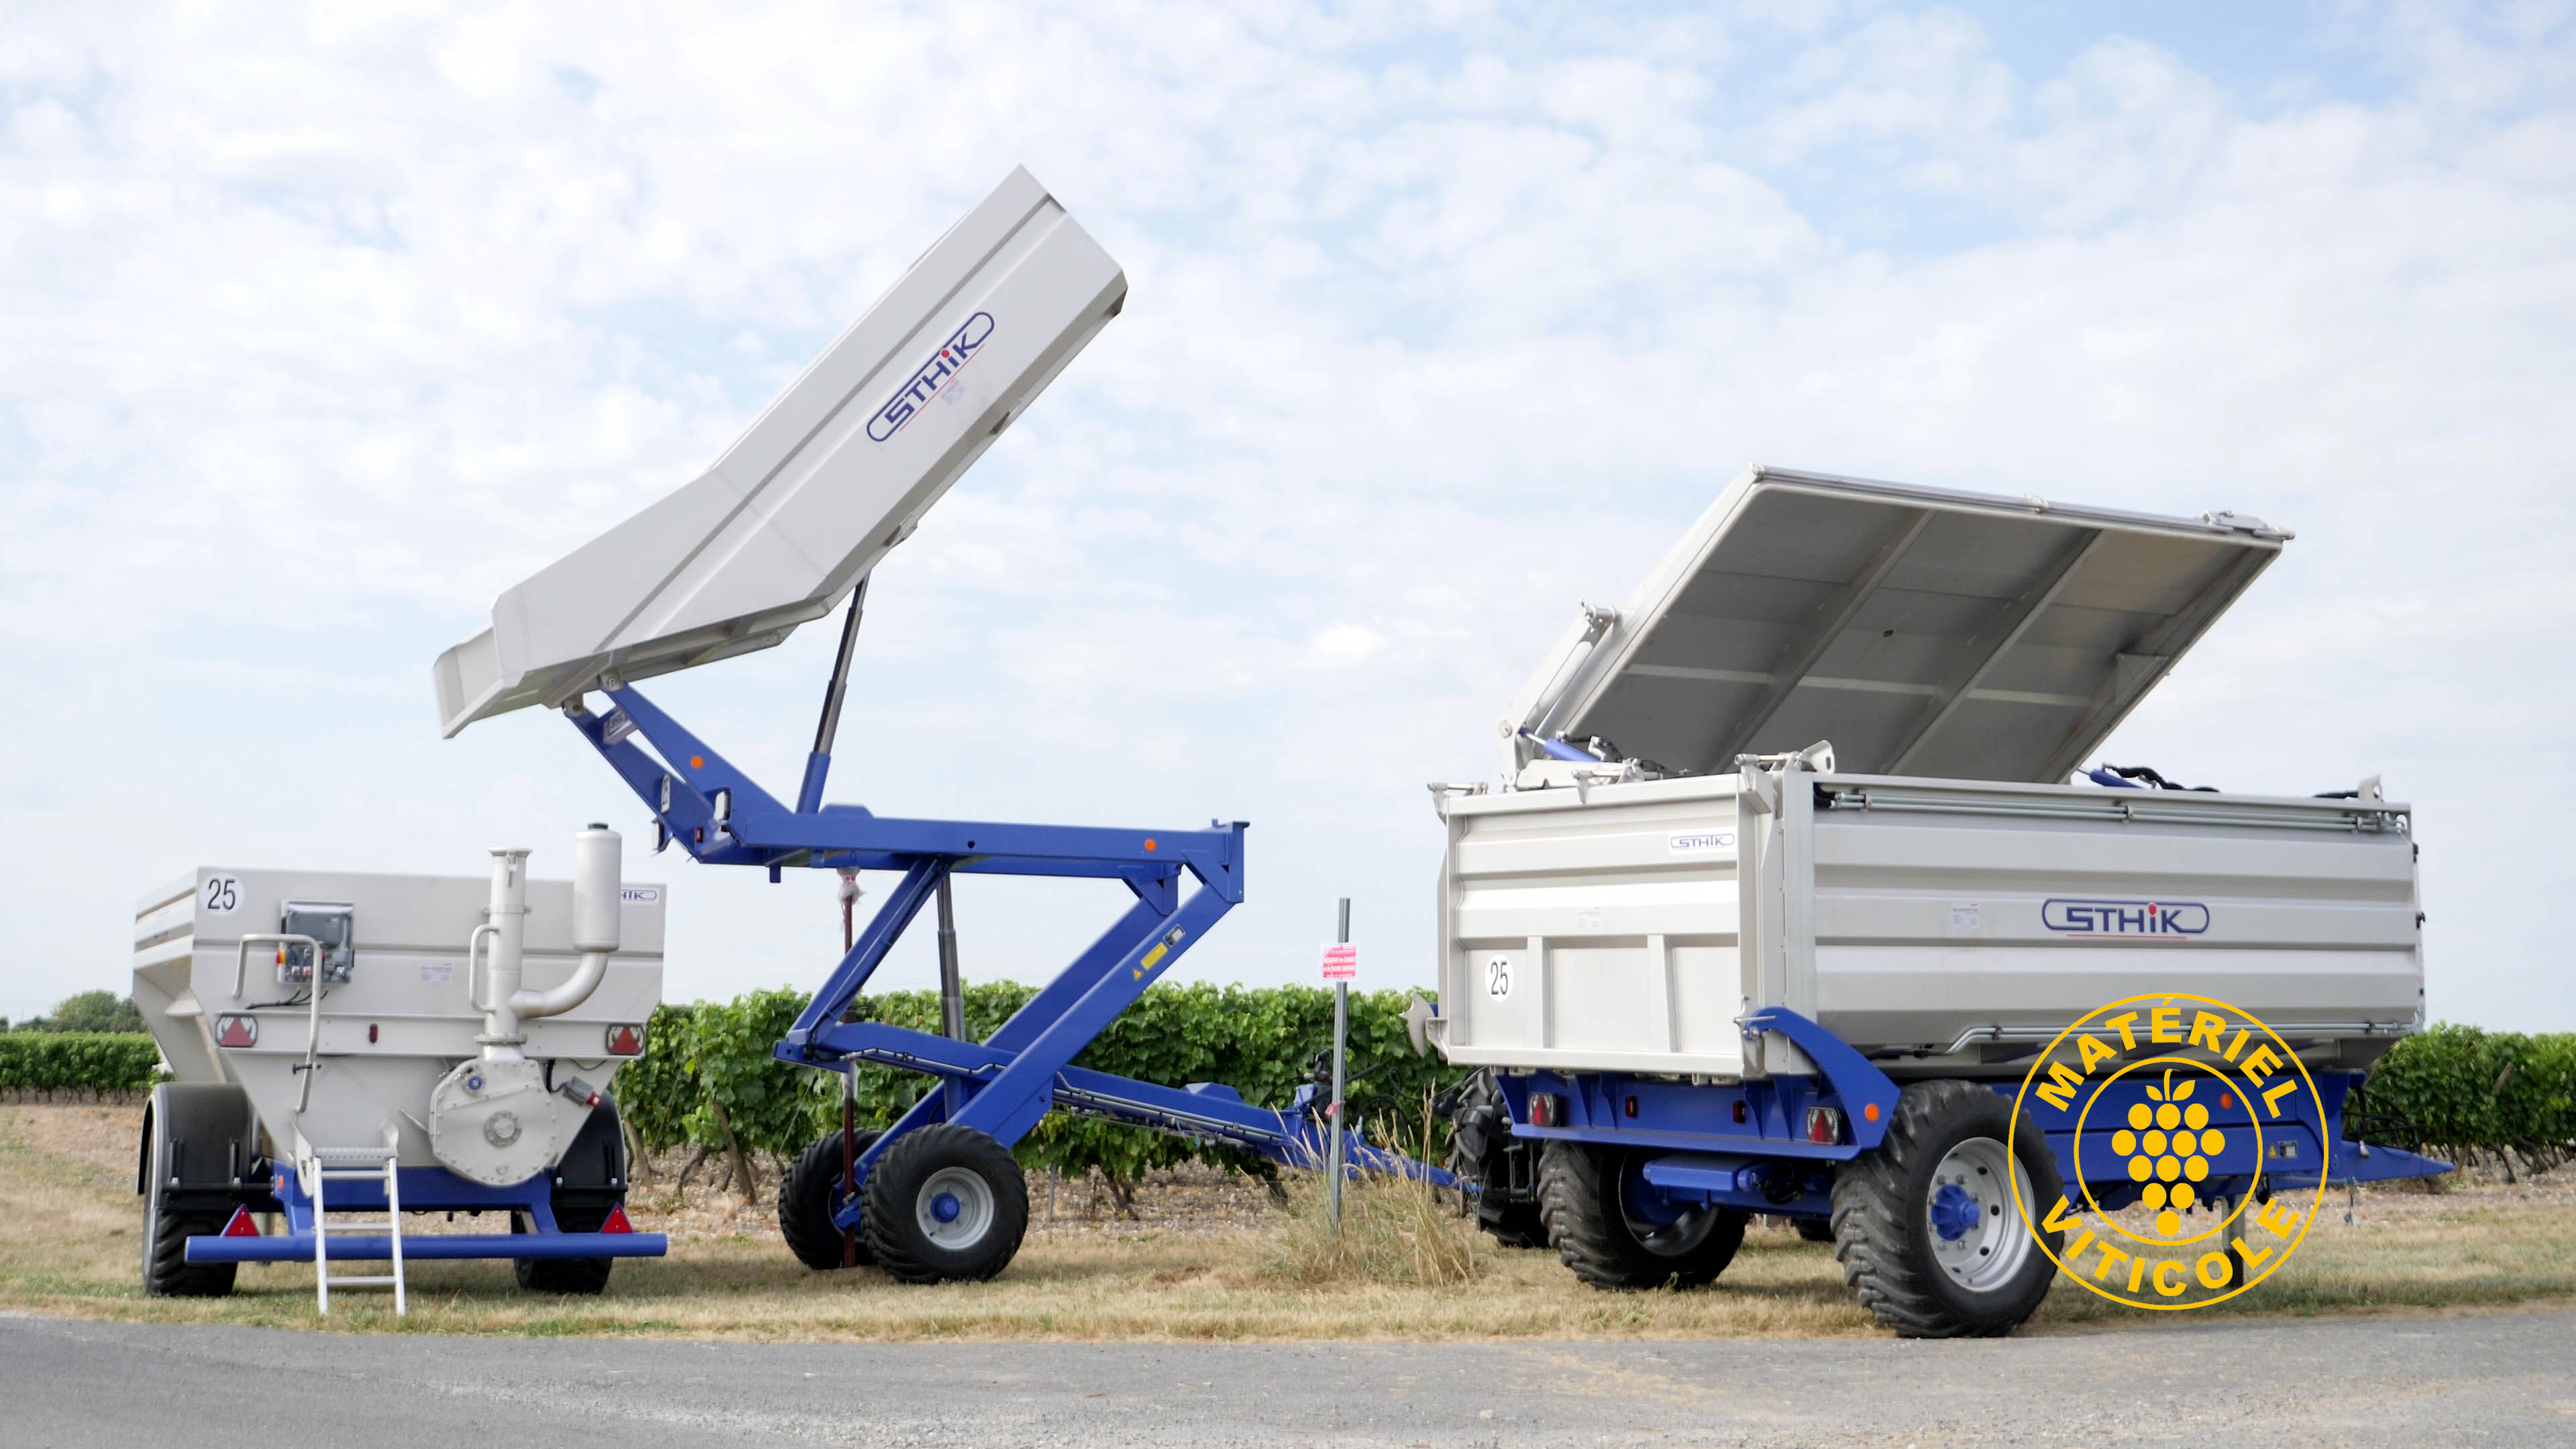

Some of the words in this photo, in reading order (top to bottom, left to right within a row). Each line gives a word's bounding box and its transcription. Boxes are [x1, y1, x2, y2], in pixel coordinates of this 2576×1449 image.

[208, 878, 236, 910] 25
[2066, 903, 2184, 933] STHiK
[1491, 961, 1508, 996] 25
